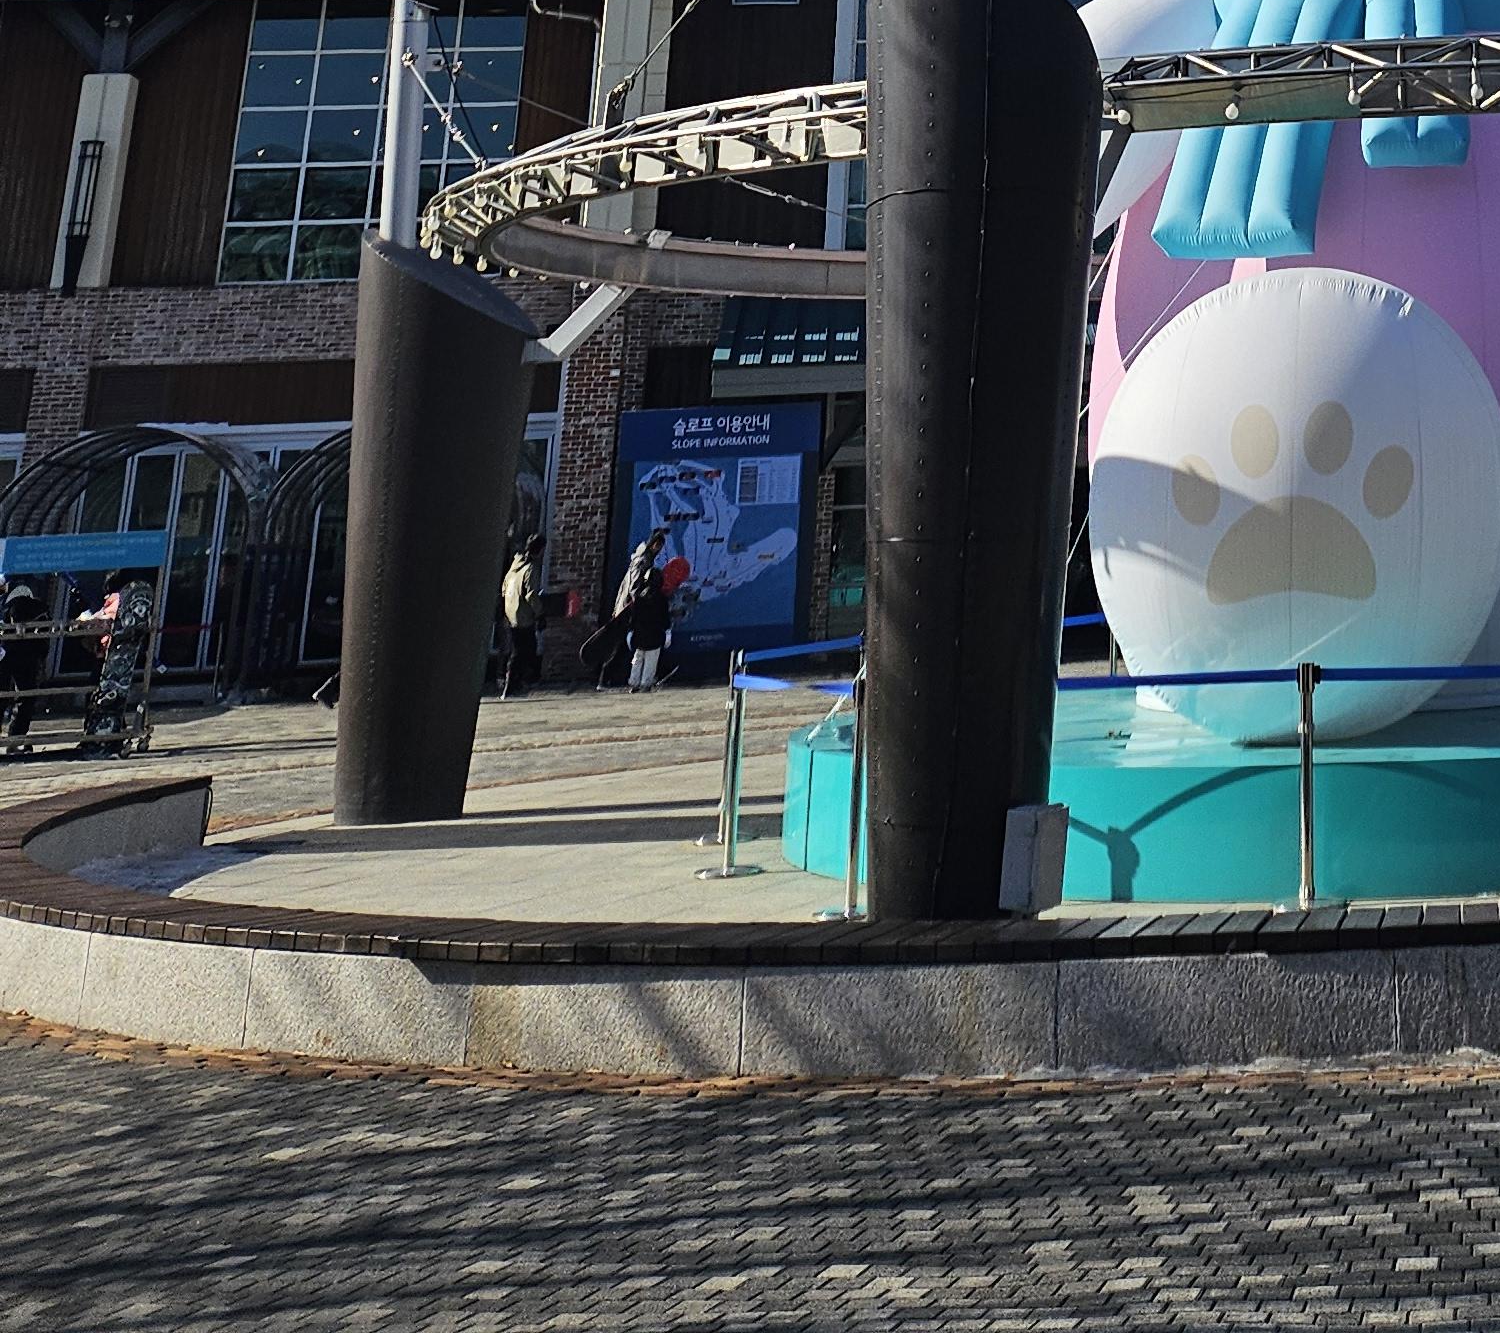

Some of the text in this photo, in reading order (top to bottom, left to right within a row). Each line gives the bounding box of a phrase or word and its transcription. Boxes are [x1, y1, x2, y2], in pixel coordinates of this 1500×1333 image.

[672, 413, 771, 437] 슬로프 이용안내
[671, 434, 770, 450] SLOPE INFORMATION
